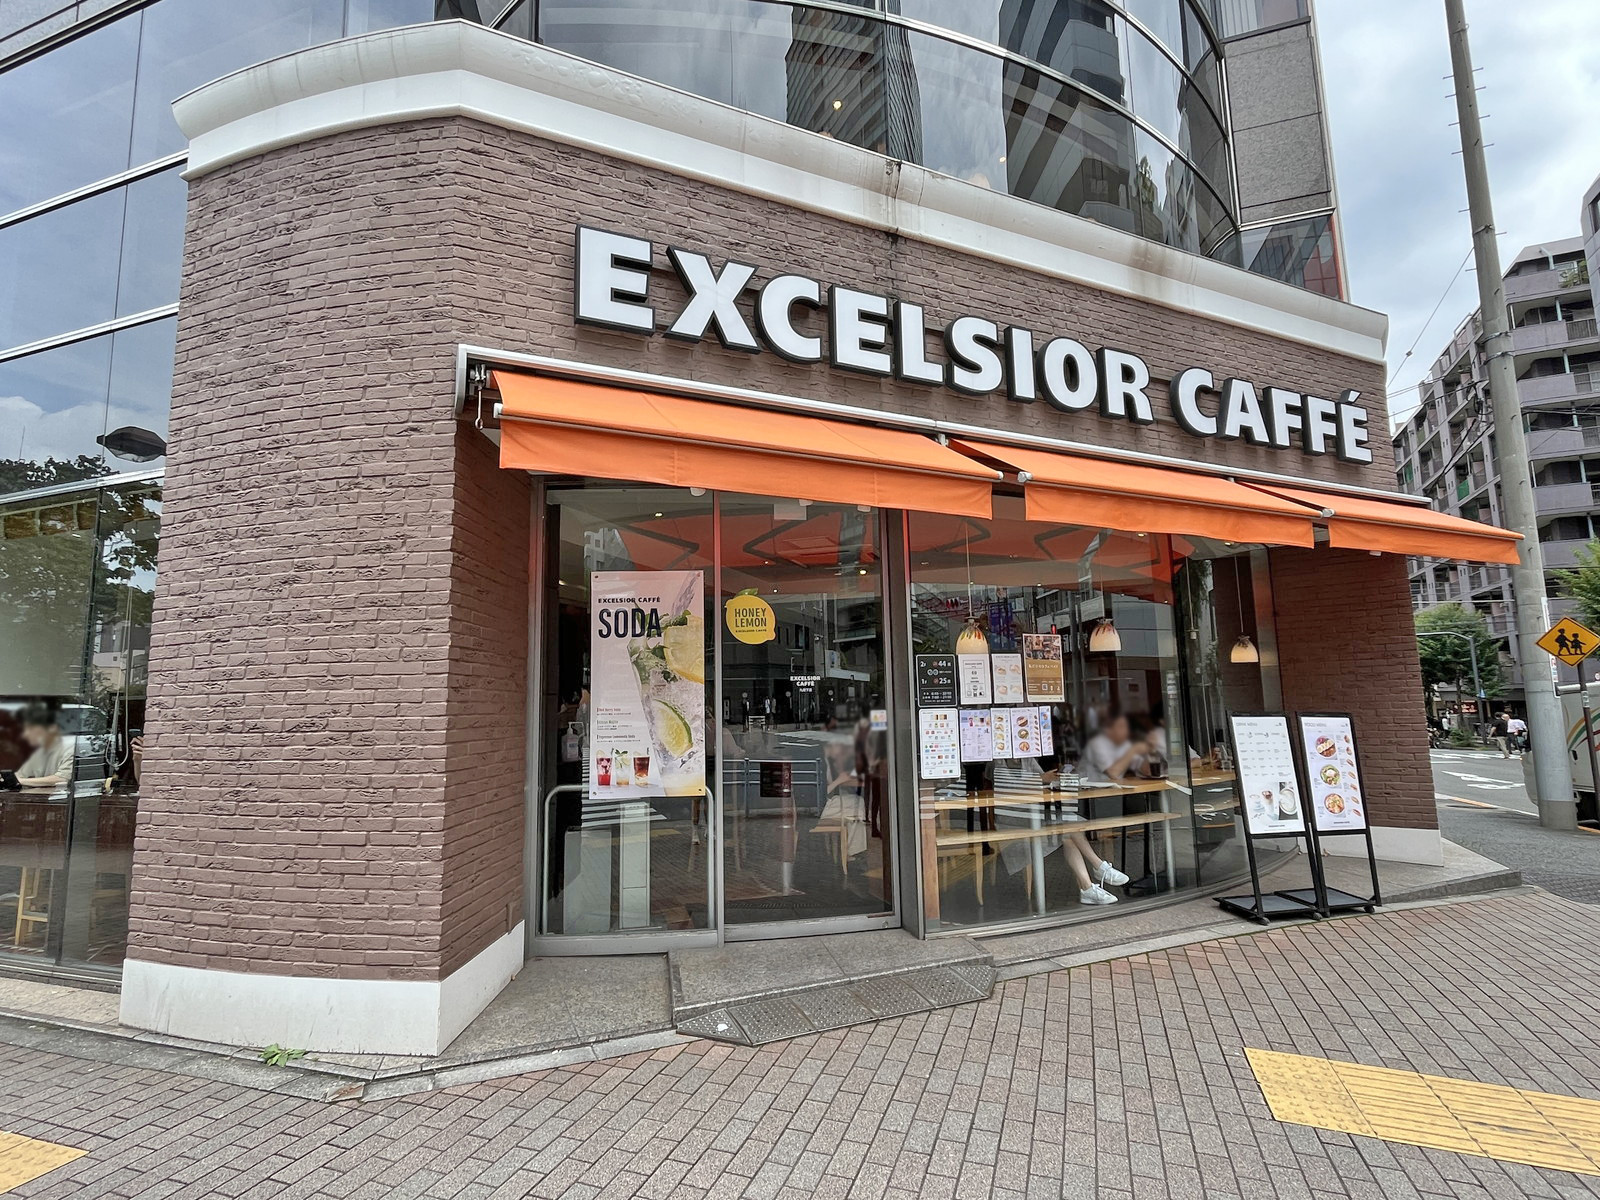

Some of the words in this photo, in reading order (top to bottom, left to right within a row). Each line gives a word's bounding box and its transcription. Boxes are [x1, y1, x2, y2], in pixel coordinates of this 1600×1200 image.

[576, 225, 1153, 424] EXCELSIOR
[1172, 366, 1373, 465] CAFFÉ
[734, 608, 766, 618] HONEY
[735, 618, 767, 628] LEMON
[598, 608, 662, 639] SODA
